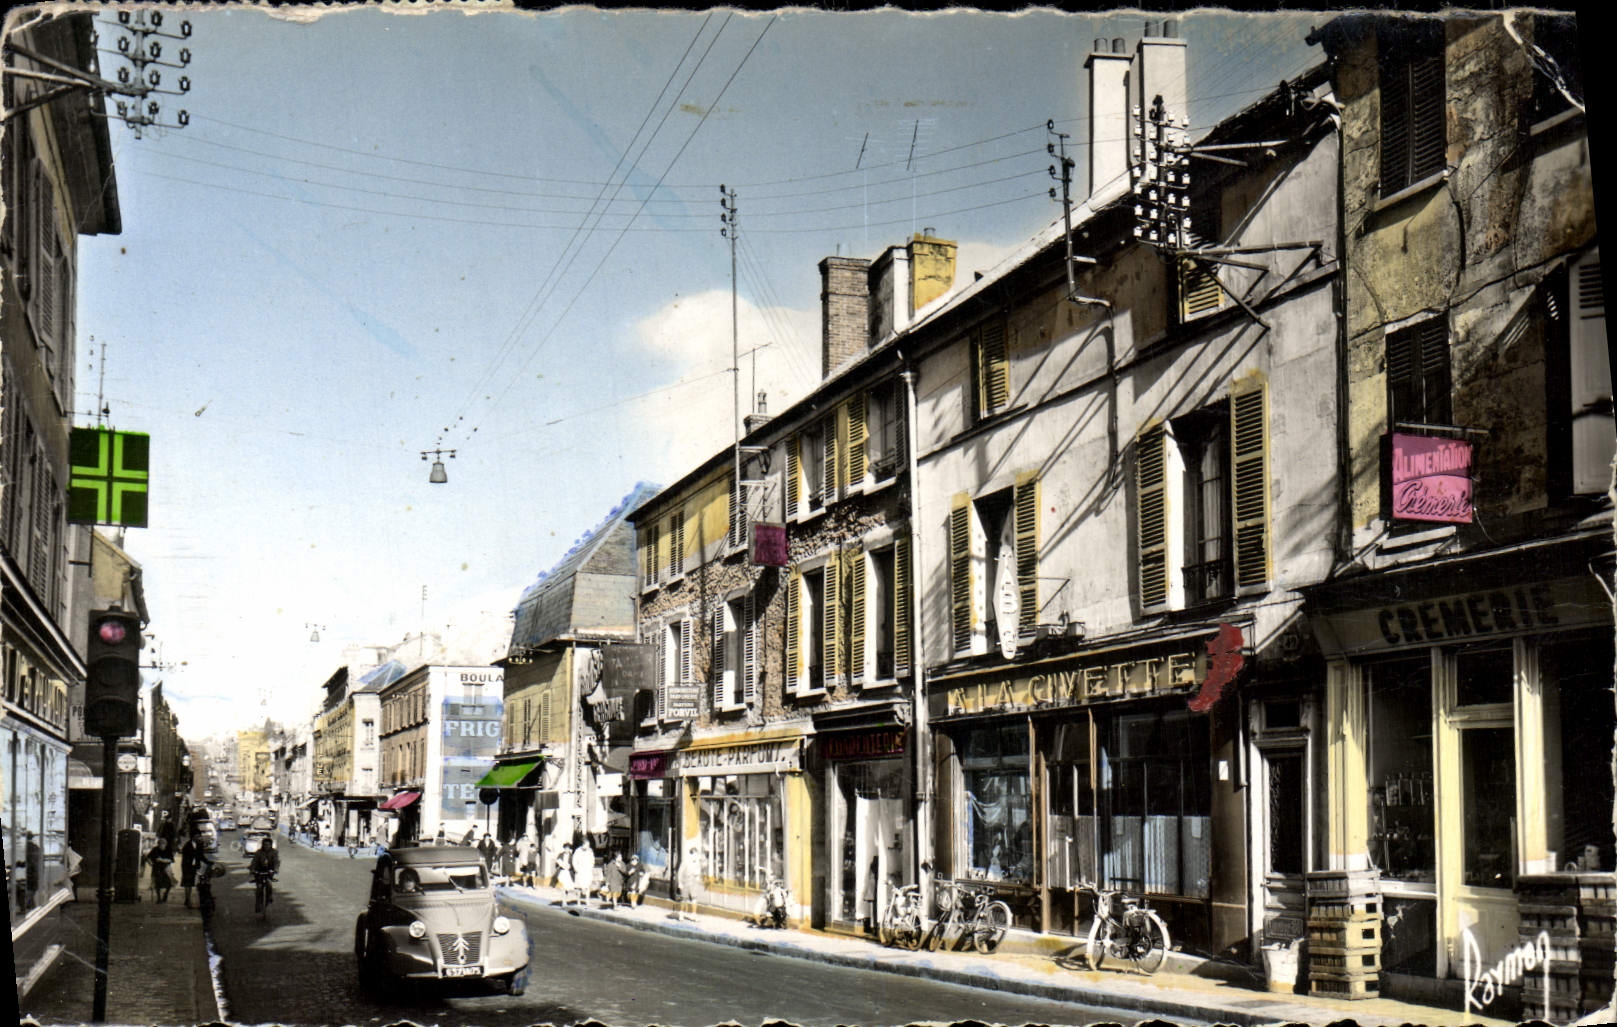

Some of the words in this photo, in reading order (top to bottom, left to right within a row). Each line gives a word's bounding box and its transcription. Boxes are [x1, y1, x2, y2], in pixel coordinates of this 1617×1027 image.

[1393, 442, 1472, 482] ALIMENTATION
[1379, 583, 1559, 644] CREMERIE
[1028, 652, 1197, 706] CIVETTE
[445, 720, 499, 737] FRIG
